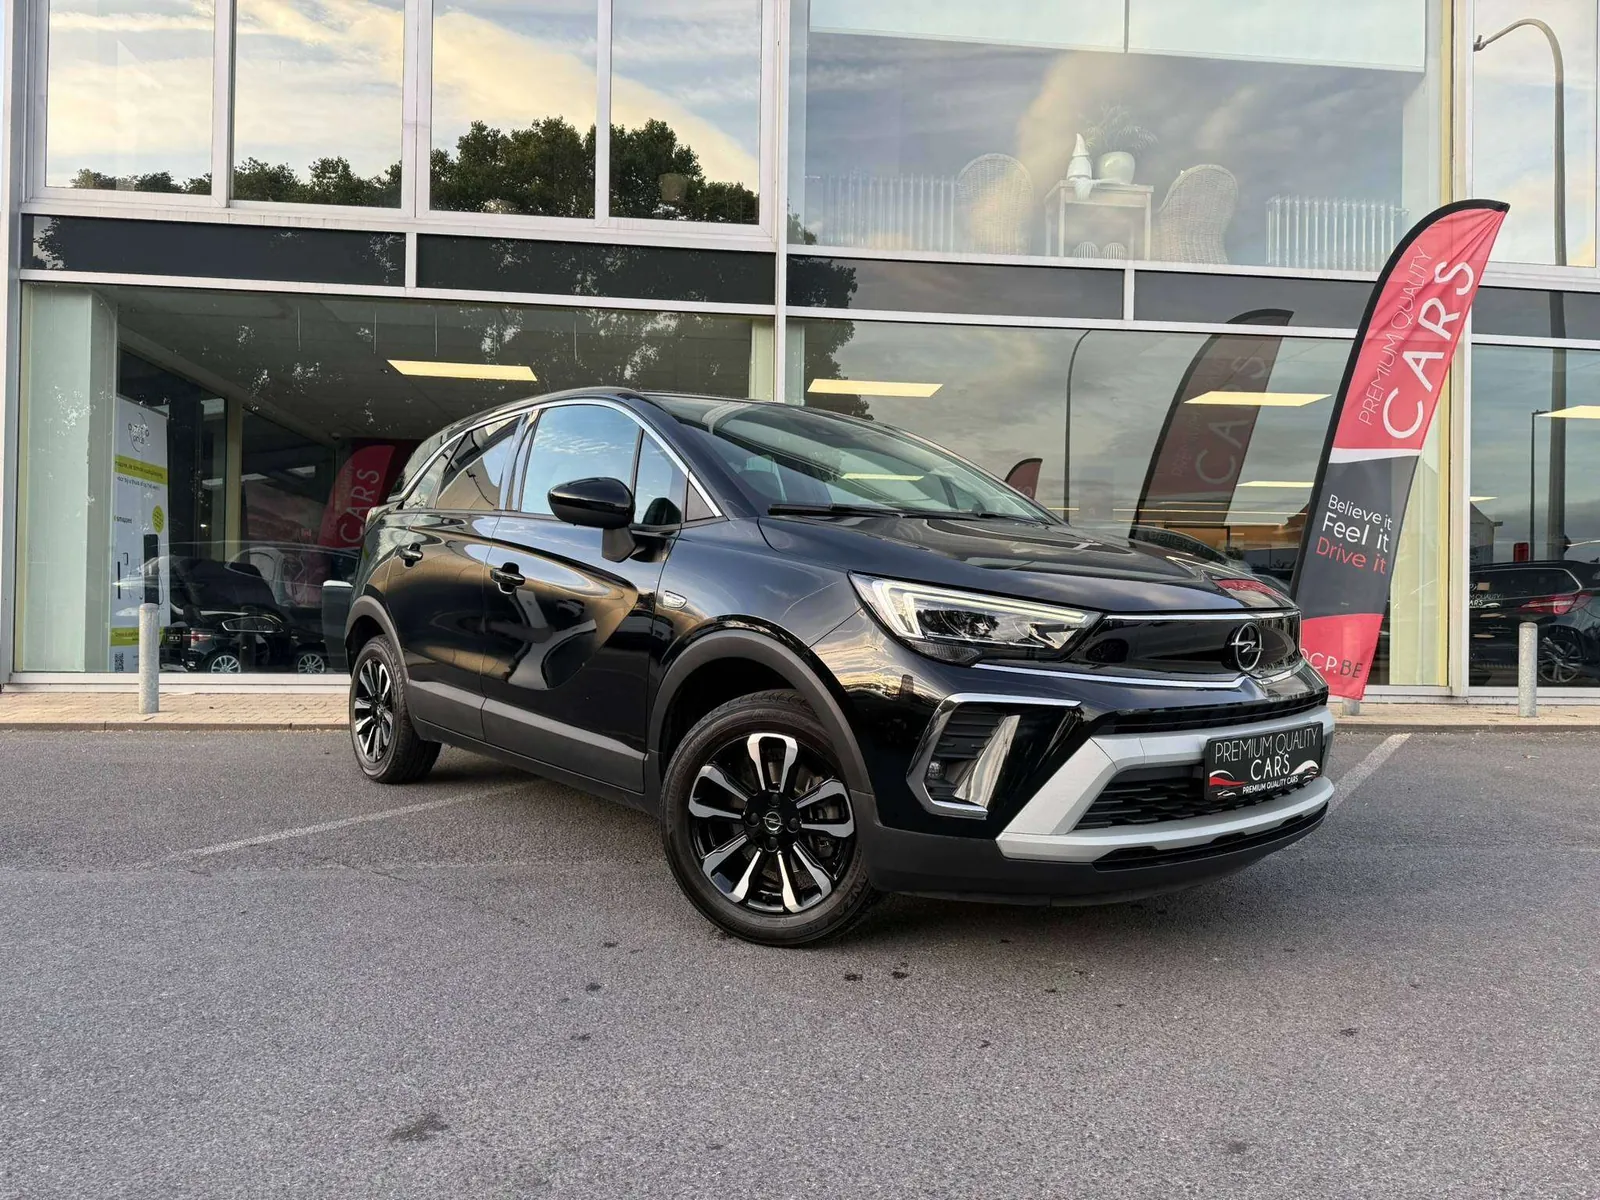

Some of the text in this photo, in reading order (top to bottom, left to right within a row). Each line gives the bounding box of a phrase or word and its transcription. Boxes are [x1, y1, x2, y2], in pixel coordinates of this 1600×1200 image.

[1358, 246, 1432, 426] PREMIUM QUALITY
[1382, 261, 1475, 439] CARS
[340, 469, 380, 543] CARS
[1327, 494, 1393, 531] Believe it
[1322, 511, 1389, 553] Feel it
[1315, 536, 1387, 575] Drive it
[1215, 727, 1319, 764] PREMIUM QUALITY
[1242, 775, 1299, 794] PREMIUM QUALITY CARS
[1250, 754, 1290, 781] CARS
